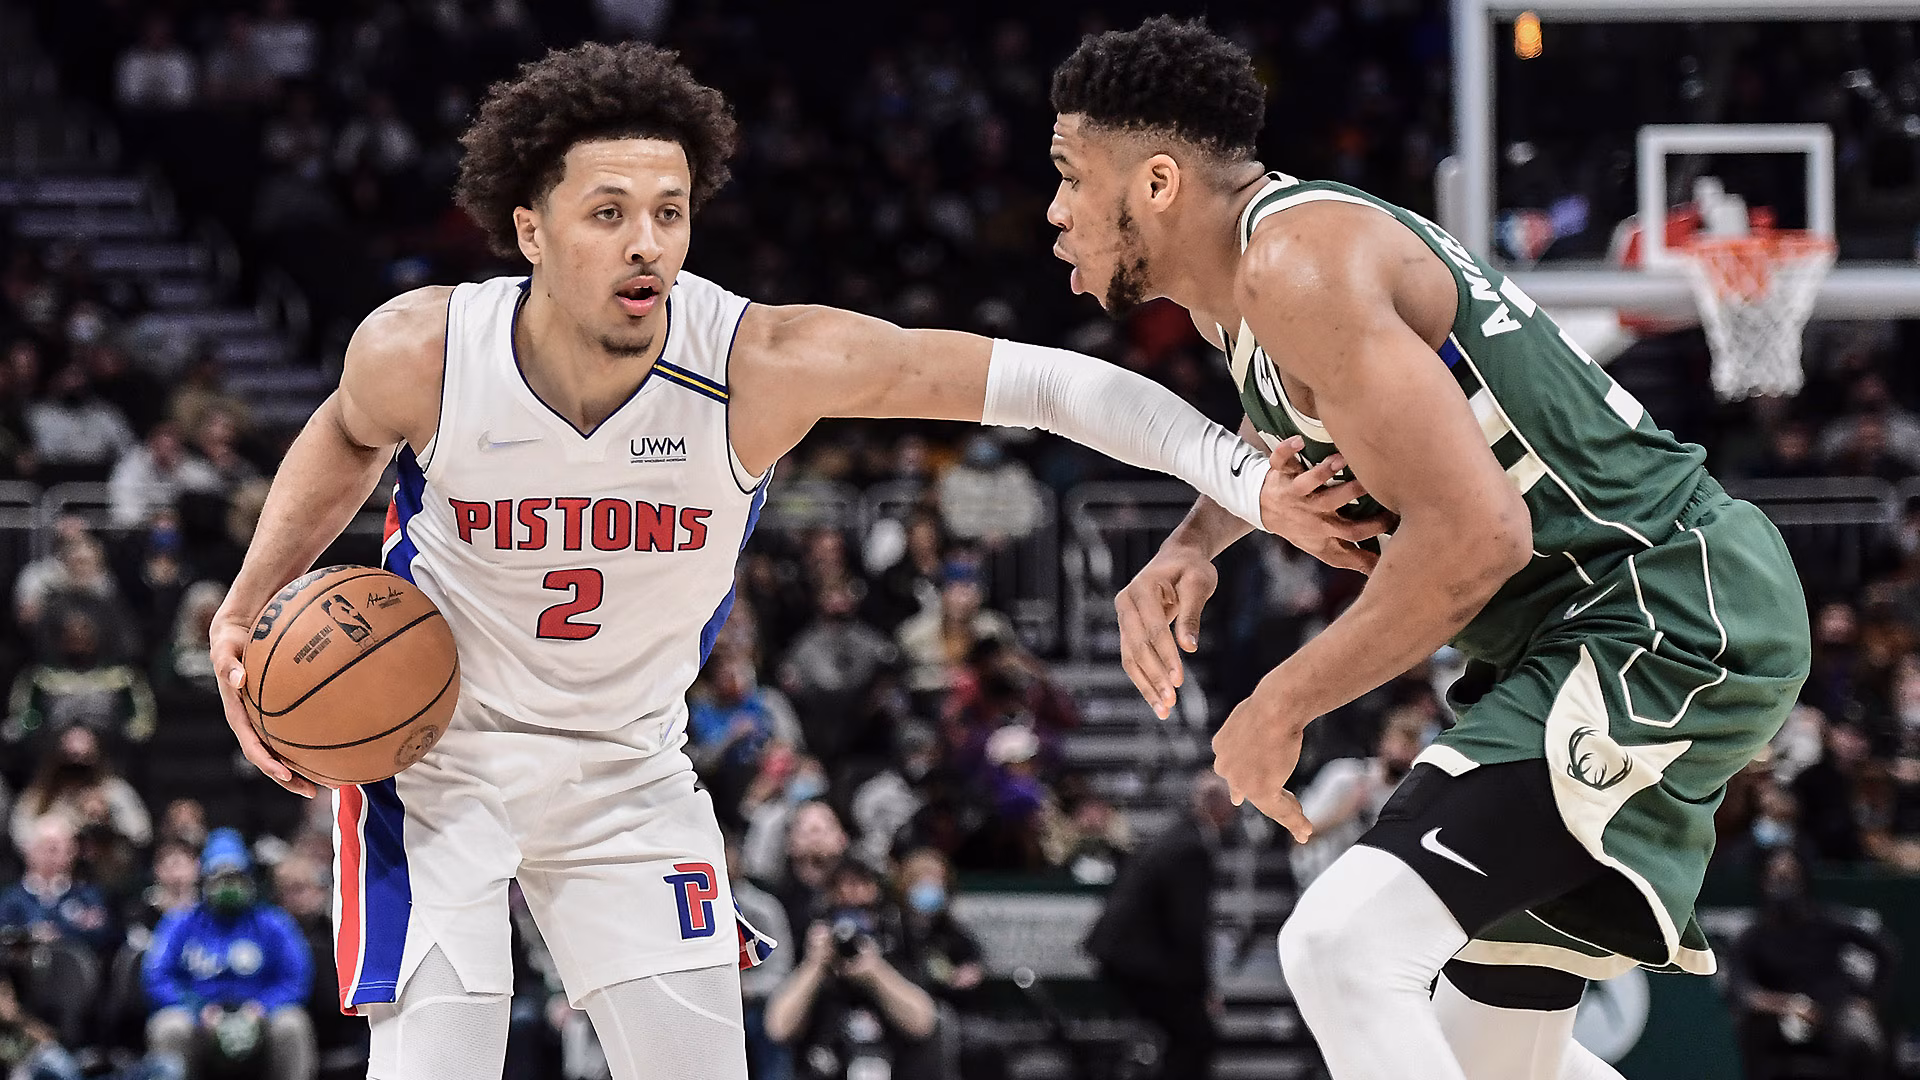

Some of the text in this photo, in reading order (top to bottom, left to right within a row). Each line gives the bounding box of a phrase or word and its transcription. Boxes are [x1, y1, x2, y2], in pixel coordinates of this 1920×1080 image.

[630, 436, 687, 457] UWM
[448, 497, 713, 553] PISTONS
[536, 567, 605, 641] 2
